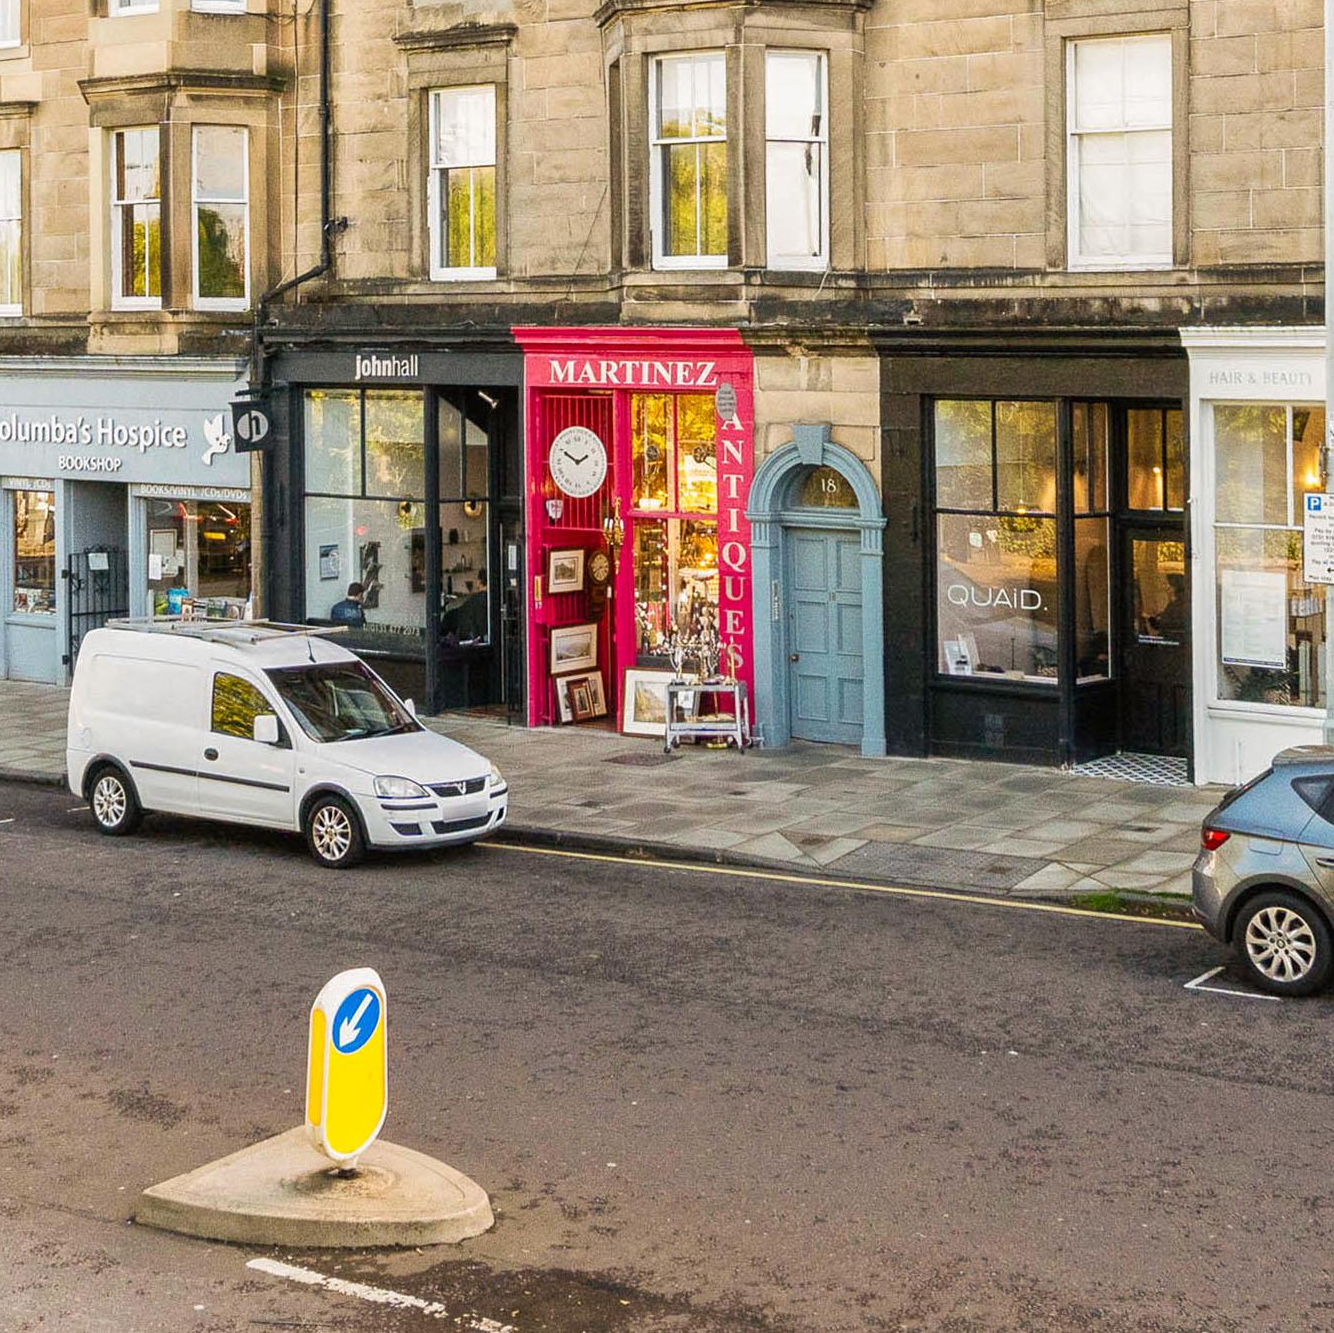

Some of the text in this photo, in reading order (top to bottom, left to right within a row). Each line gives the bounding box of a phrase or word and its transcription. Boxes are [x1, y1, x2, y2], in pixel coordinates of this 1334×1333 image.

[354, 355, 418, 380] johnhall
[549, 360, 717, 386] MARTINEZ
[1209, 370, 1243, 384] HAIR
[1263, 372, 1313, 385] BEAUTY
[97, 418, 188, 453] Hospice
[58, 455, 123, 472] BOOKSHOP
[821, 478, 837, 493] 18
[720, 412, 747, 669] ANTIQUES
